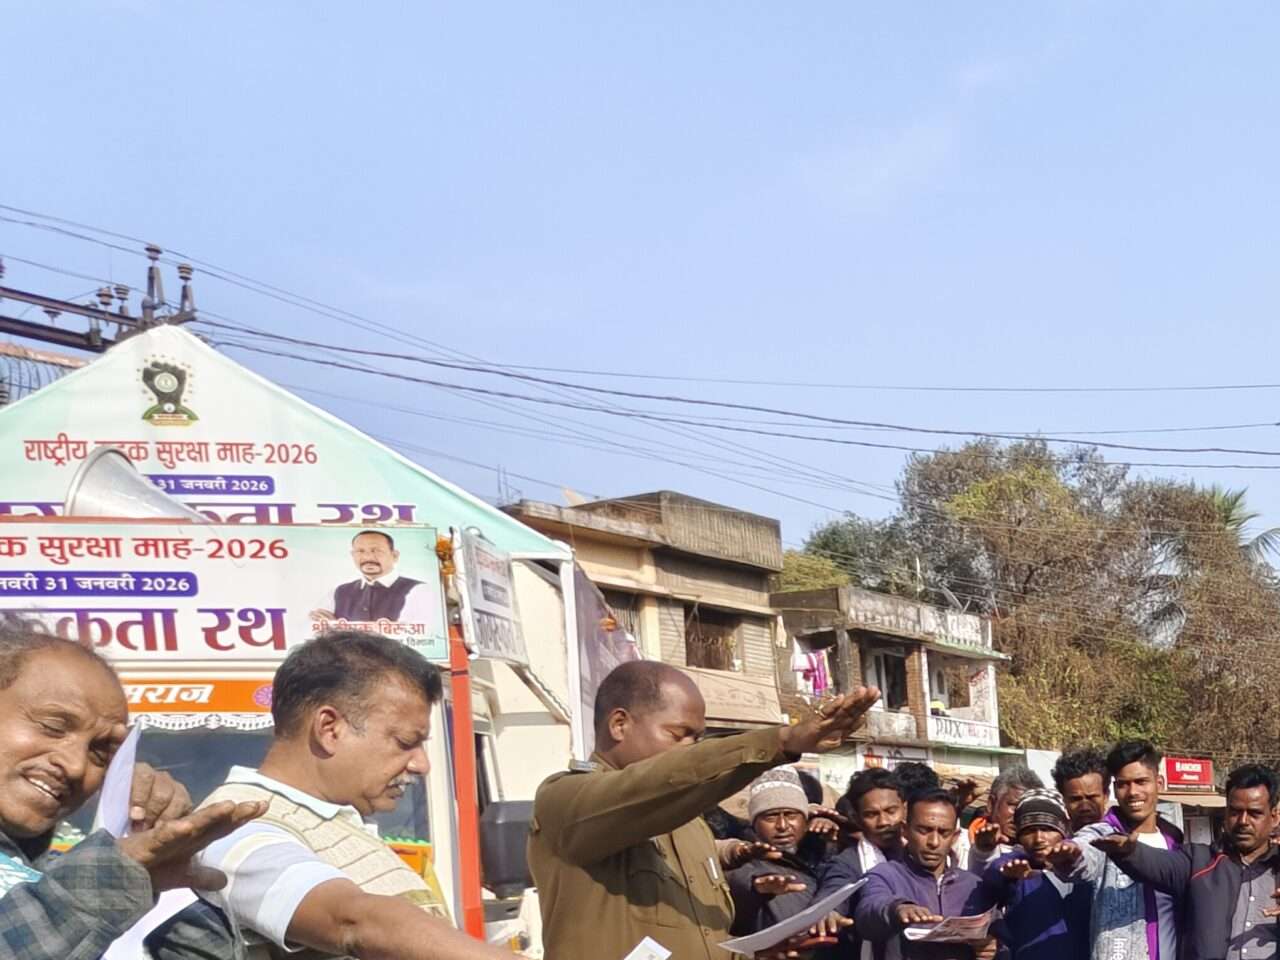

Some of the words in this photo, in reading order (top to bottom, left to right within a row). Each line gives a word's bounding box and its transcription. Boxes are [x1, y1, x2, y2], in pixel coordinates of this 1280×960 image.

[23, 433, 88, 466] राष्ट्रीय
[155, 441, 210, 469] सुरक्षा
[215, 441, 319, 465] माह-2026
[180, 476, 227, 491] जनवरी
[231, 479, 269, 492] 2026
[38, 536, 123, 565] सुरक्षा
[131, 537, 290, 560] माह-2026
[45, 577, 68, 591] 31
[74, 573, 136, 591] जनवरी
[142, 577, 191, 592] 2026
[196, 607, 288, 652] रथ
